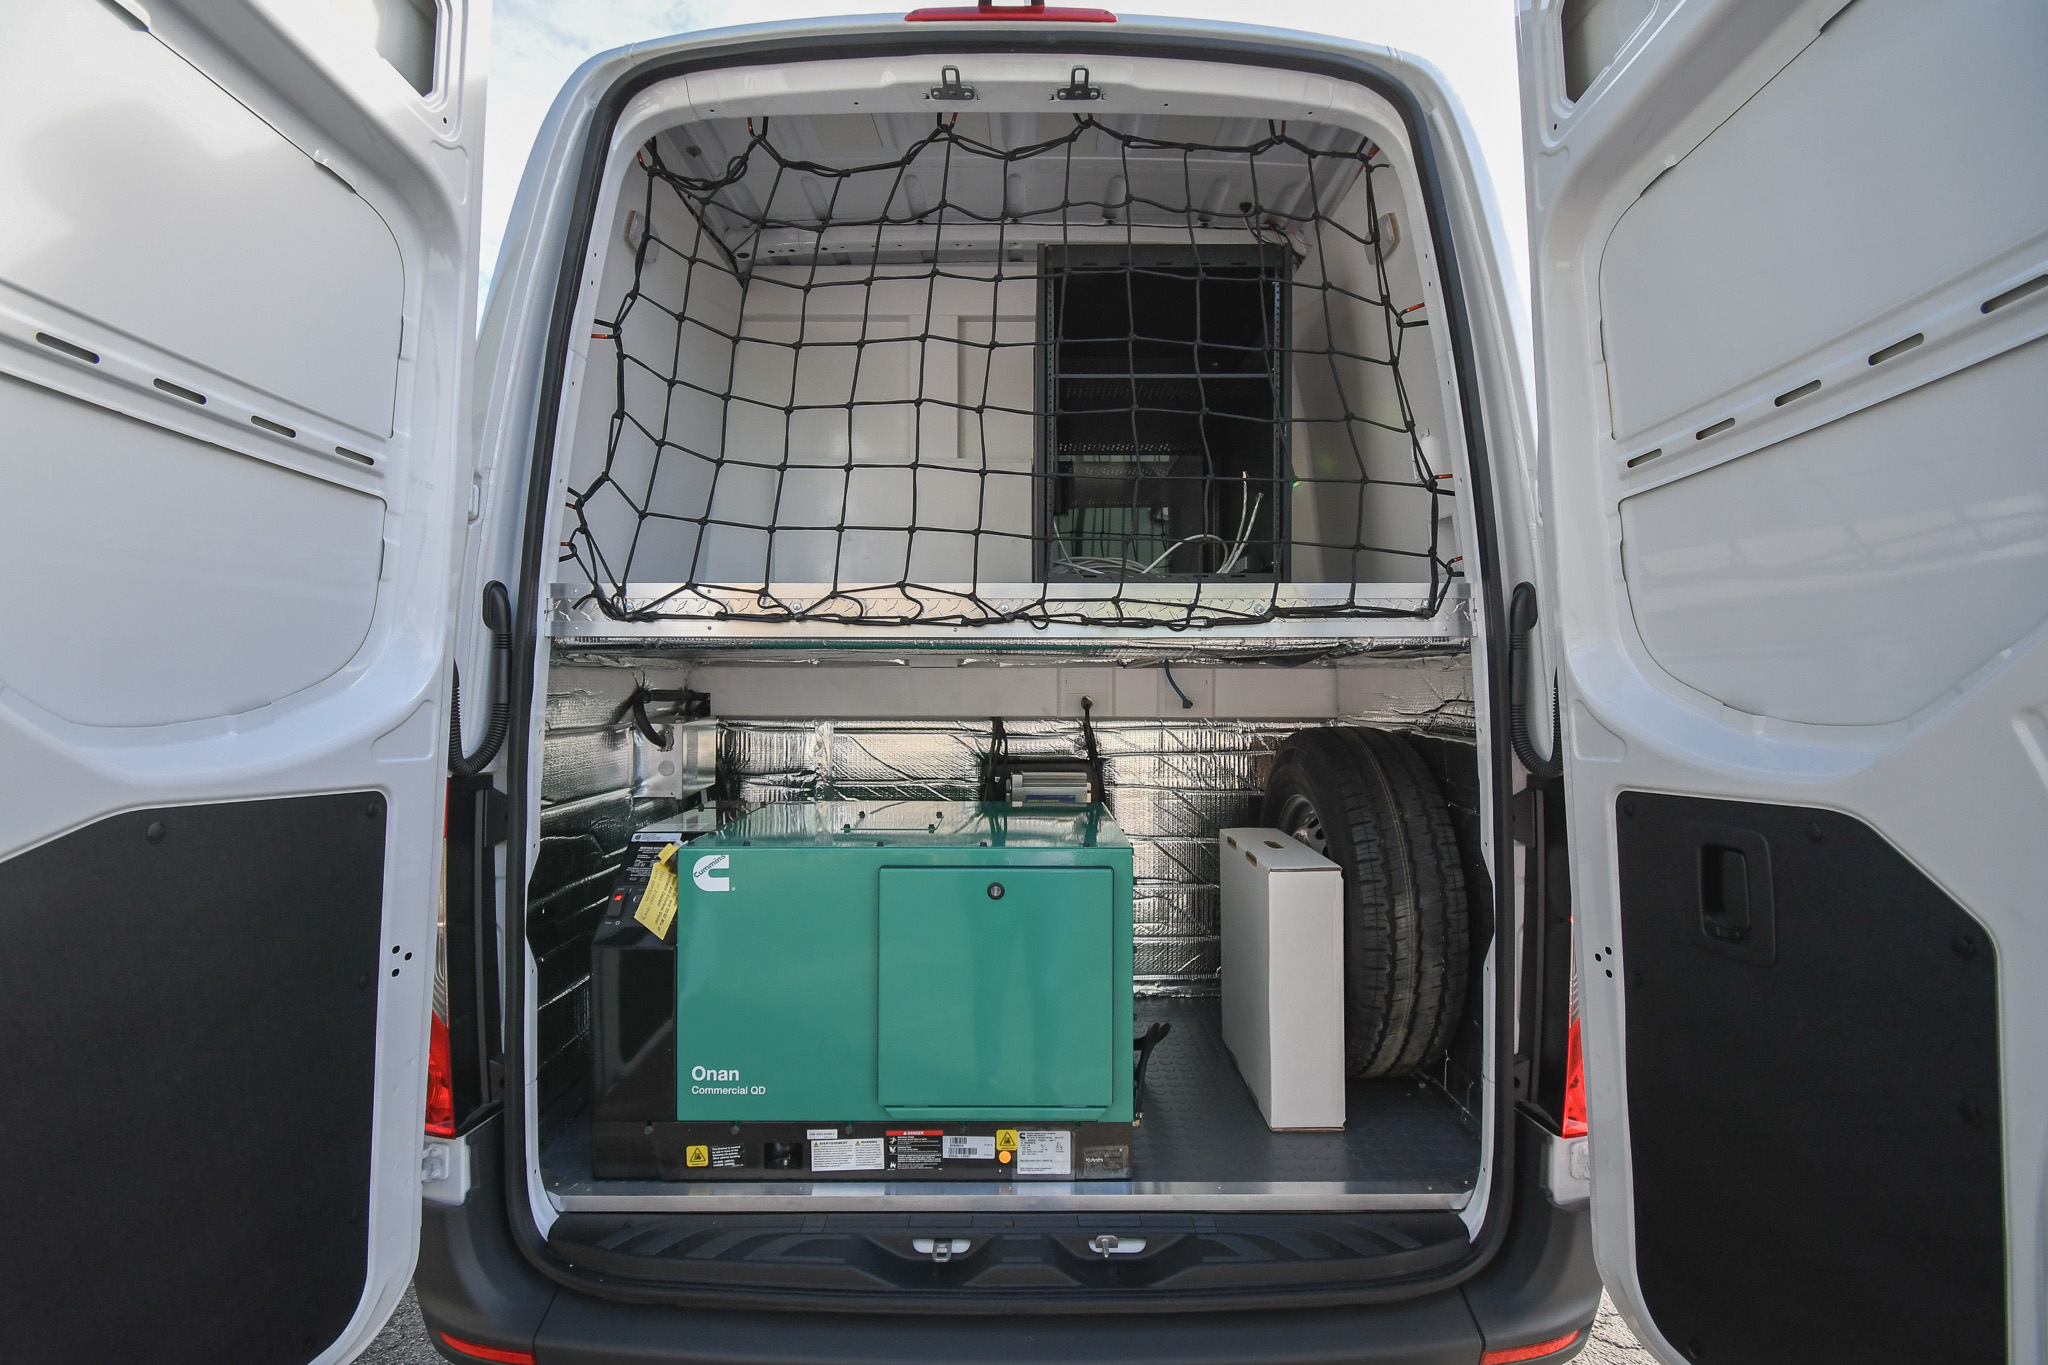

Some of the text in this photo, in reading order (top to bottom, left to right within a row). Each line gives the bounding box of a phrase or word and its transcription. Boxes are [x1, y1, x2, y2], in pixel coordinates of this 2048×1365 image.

[693, 855, 726, 878] Cummins
[691, 1065, 740, 1082] Onan
[691, 1085, 766, 1095] Commercial QD
